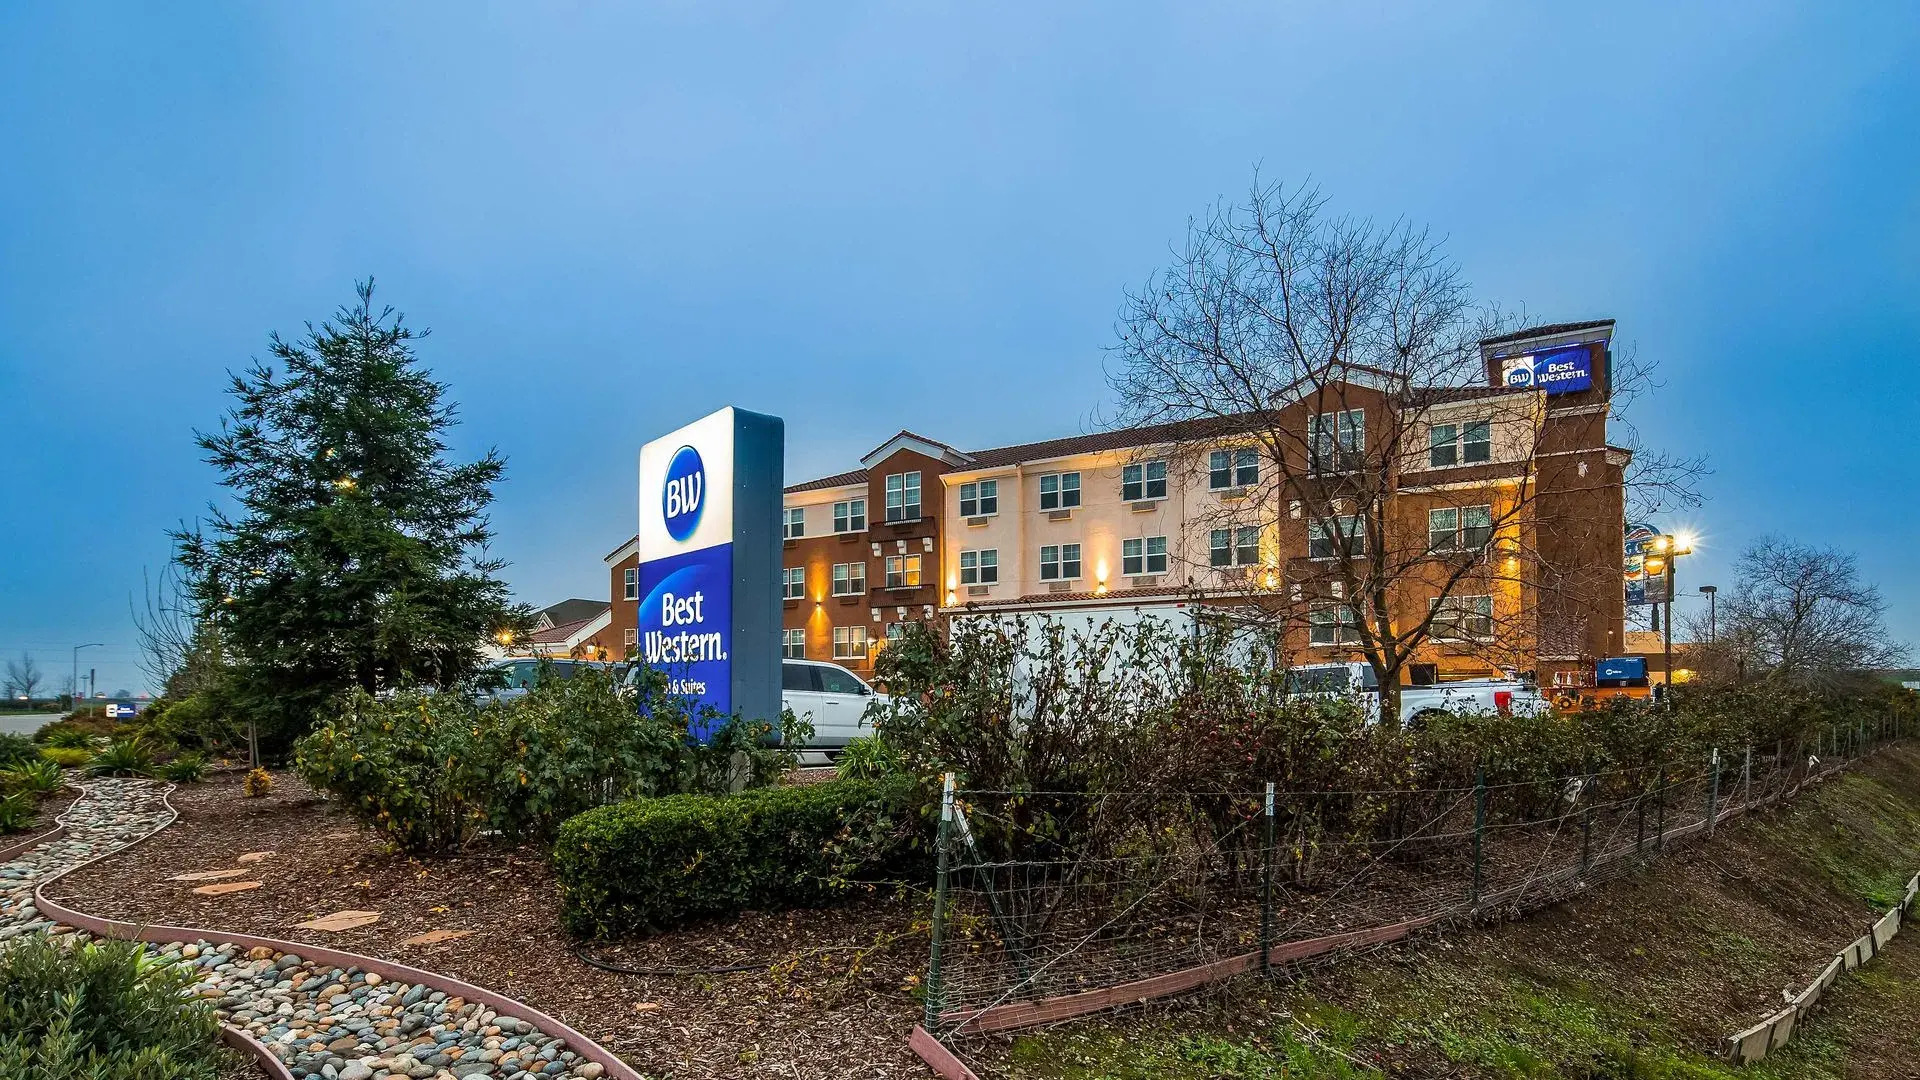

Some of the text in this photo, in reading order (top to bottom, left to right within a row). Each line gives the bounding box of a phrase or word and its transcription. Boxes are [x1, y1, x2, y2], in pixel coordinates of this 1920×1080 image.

[1510, 373, 1529, 384] BW
[1548, 361, 1575, 373] Best
[667, 471, 701, 519] BW
[662, 591, 704, 627] Best
[645, 630, 728, 664] Western.
[672, 679, 679, 695] &
[680, 678, 706, 695] Suites
